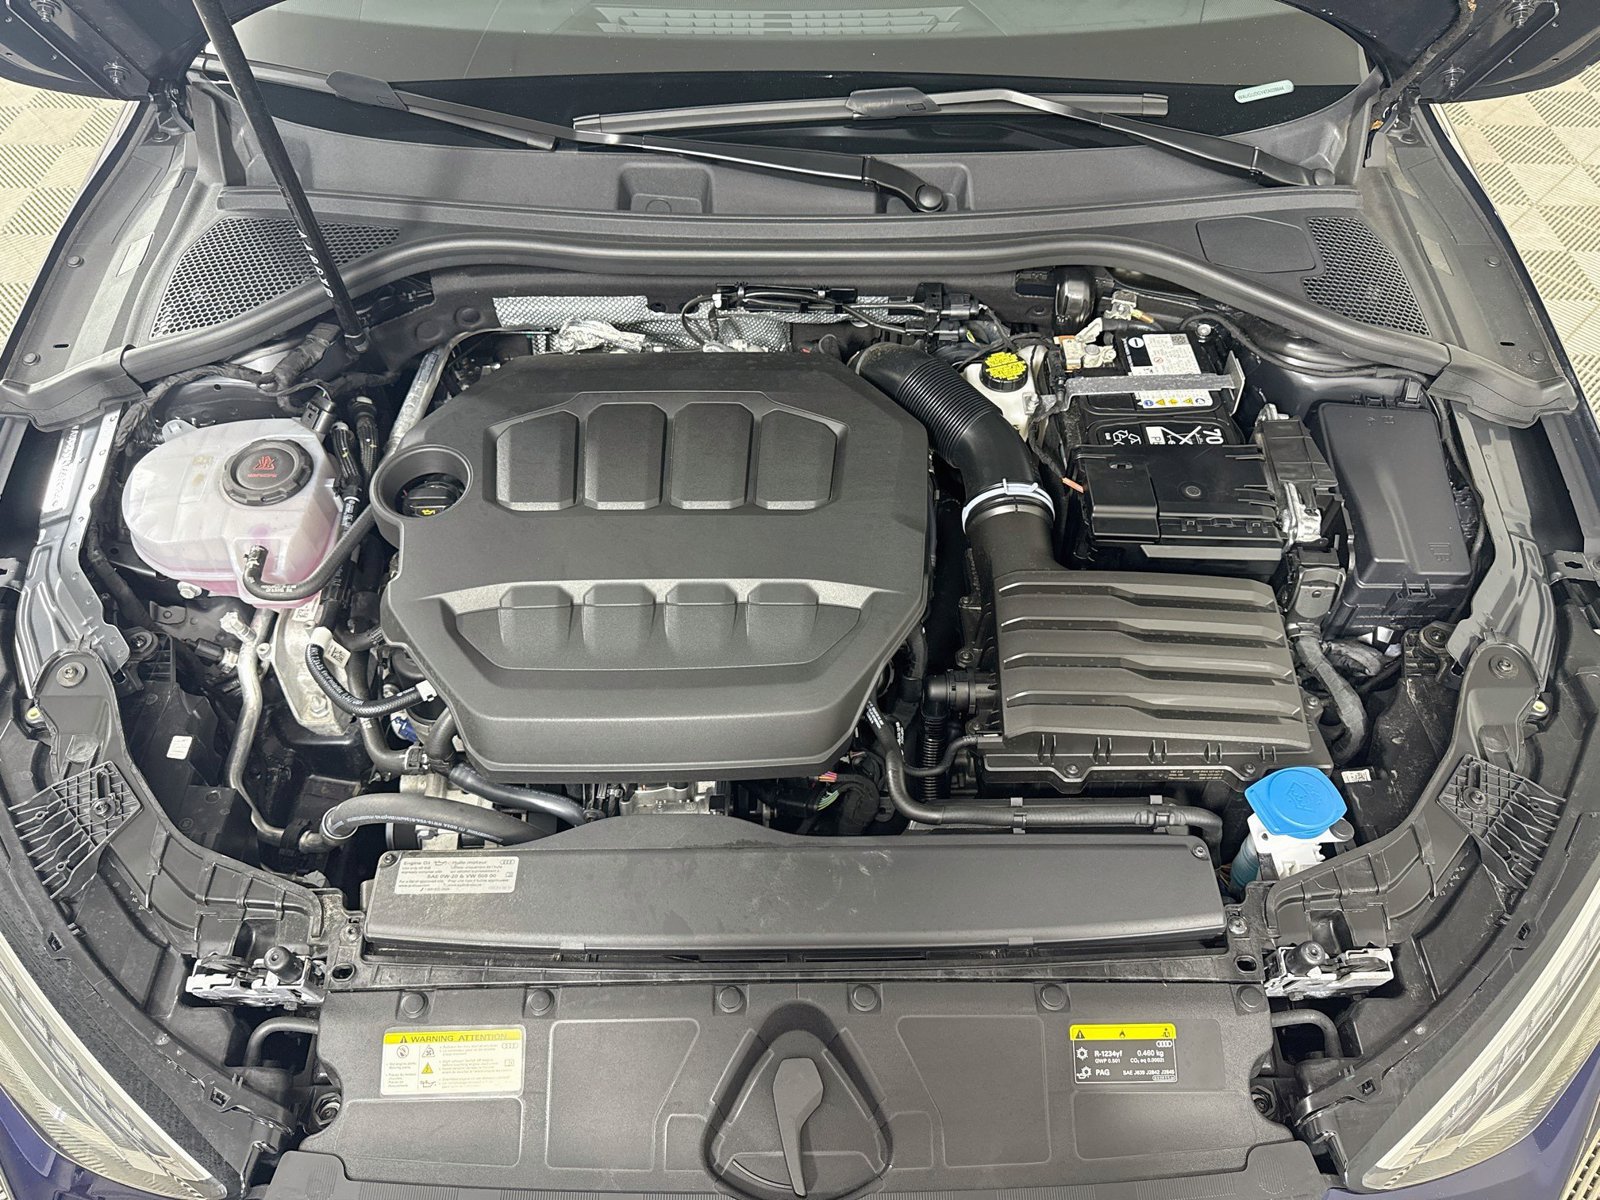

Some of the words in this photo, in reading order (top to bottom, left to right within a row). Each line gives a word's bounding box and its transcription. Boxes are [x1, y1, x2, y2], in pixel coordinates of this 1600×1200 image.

[1203, 428, 1224, 445] 70
[411, 1035, 454, 1043] WARNING
[458, 1033, 507, 1041] ATTENTION
[1094, 1050, 1122, 1058] R-1234yf
